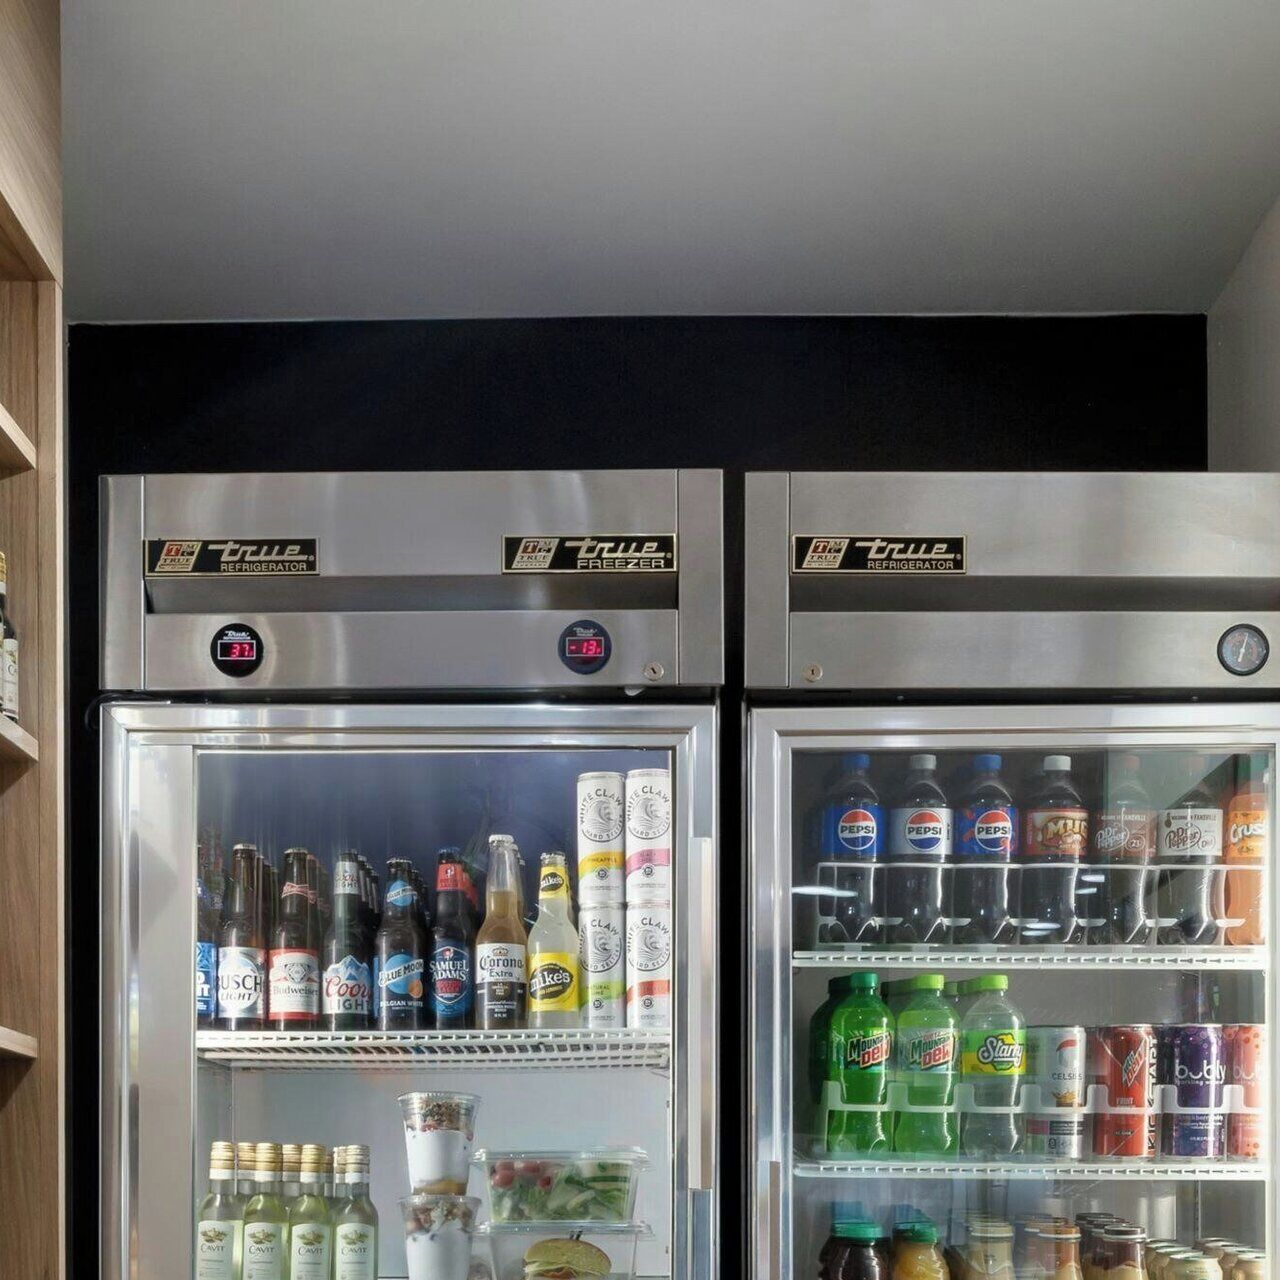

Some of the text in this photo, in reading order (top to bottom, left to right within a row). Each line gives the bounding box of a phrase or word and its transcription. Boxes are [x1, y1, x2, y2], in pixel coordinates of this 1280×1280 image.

[220, 562, 307, 573] REFRIGERATOR
[577, 558, 665, 569] FREEZER
[867, 560, 954, 570] REFRIGERATOR
[594, 787, 623, 807] CLAW
[641, 785, 670, 804] CLAW
[840, 824, 875, 835] PEPSI
[907, 826, 942, 836] PEPSI
[977, 825, 1011, 836] PEPSI
[590, 918, 620, 937] CLAW
[641, 917, 670, 936] CLAW
[429, 960, 469, 972] SAMUEL
[433, 970, 467, 982] ADAMS
[489, 970, 513, 979] Extra
[531, 970, 571, 992] mike's
[1051, 1072, 1084, 1081] CELSIUS
[1175, 1059, 1226, 1085] bubly
[200, 1243, 226, 1255] CAVIT
[248, 1244, 276, 1256] CAVIT
[341, 1244, 368, 1256] CAVIT
